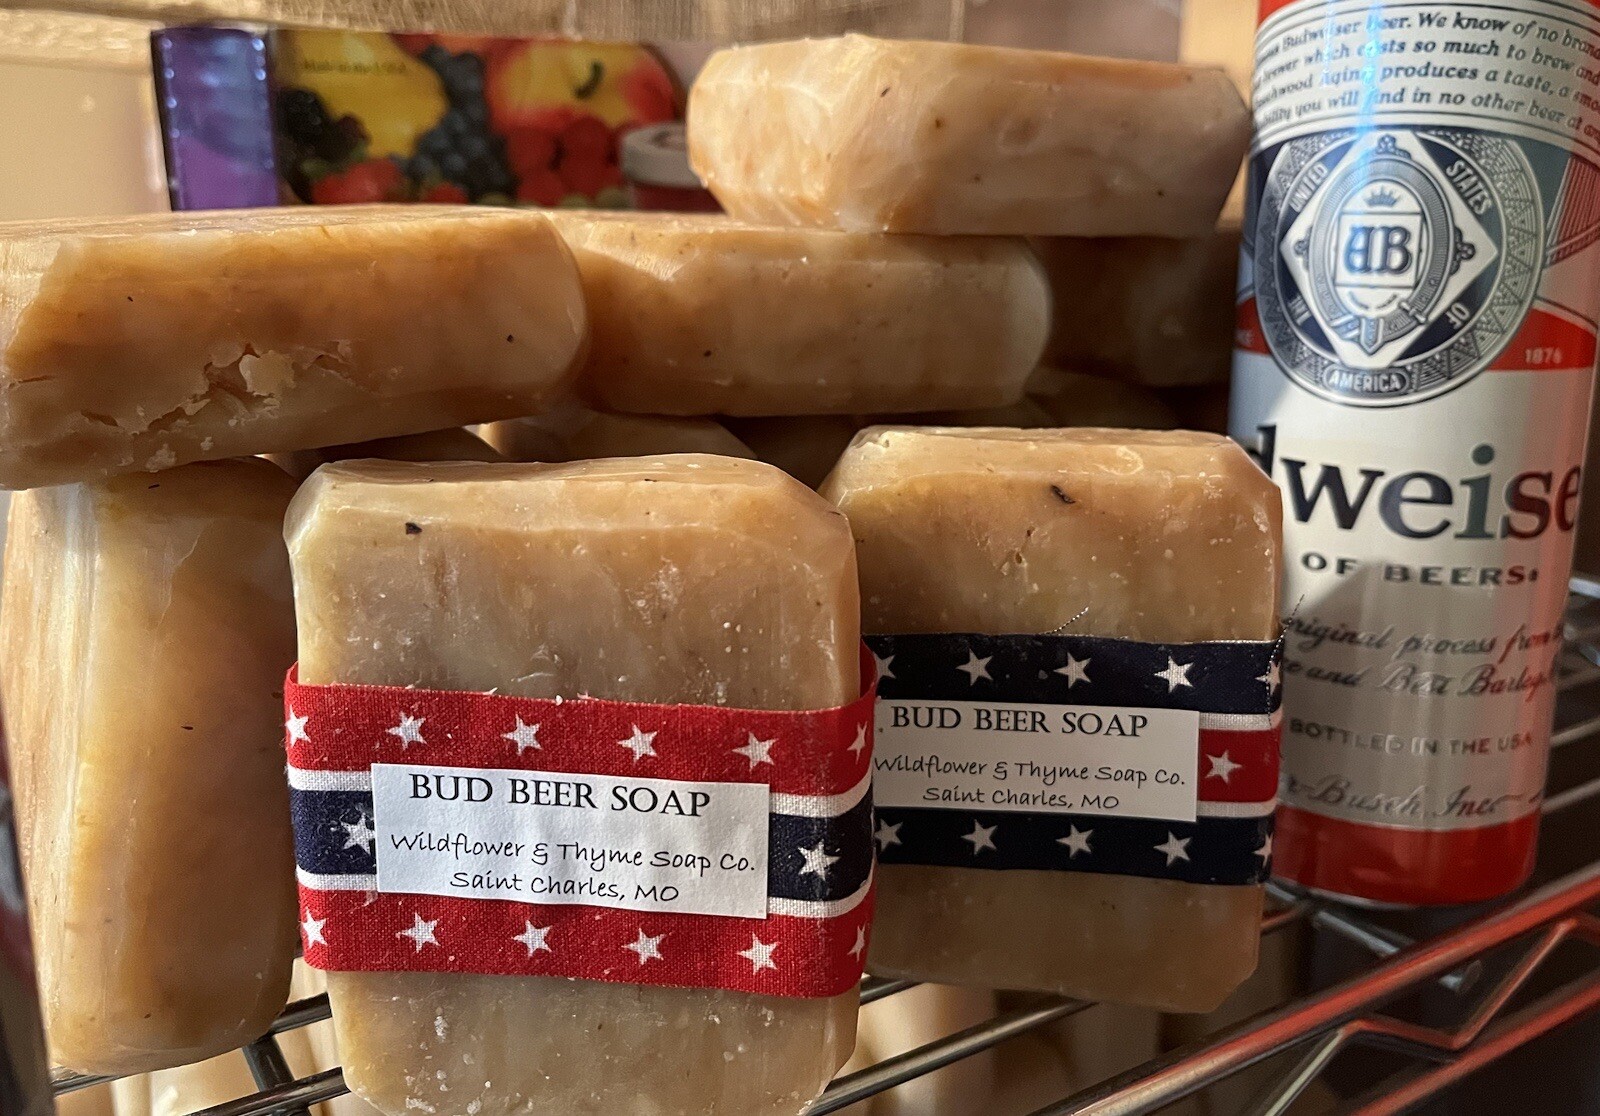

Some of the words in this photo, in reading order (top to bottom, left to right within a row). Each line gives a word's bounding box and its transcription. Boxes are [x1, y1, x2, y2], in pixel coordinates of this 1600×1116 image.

[1418, 12, 1447, 28] We
[1452, 12, 1511, 31] know
[1512, 20, 1537, 39] of
[1536, 26, 1558, 42] no
[1304, 43, 1350, 63] whch
[1357, 39, 1406, 57] csts
[1412, 39, 1436, 54] so
[1443, 39, 1500, 57] much
[1505, 44, 1527, 61] to
[1531, 48, 1576, 70] brew
[1380, 61, 1478, 82] produces
[1485, 69, 1499, 82] a
[1504, 69, 1554, 96] taste,
[1559, 86, 1570, 98] a
[1329, 90, 1359, 108] will
[1412, 87, 1432, 104] in
[1439, 91, 1465, 105] no
[1470, 92, 1525, 113] other
[1528, 99, 1566, 122] beer
[1289, 163, 1328, 213] UNITED
[1446, 160, 1492, 215] STATES
[1444, 302, 1470, 329] OF
[1328, 370, 1402, 393] AMERICA
[1302, 552, 1358, 575] OF
[891, 705, 961, 729] BUD
[973, 707, 1052, 734] BEER
[1061, 711, 1149, 738] SOAP
[1290, 718, 1404, 755] BOTTLED
[1450, 737, 1491, 756] THE
[874, 754, 986, 779] Wildflower
[993, 761, 1009, 781] &
[1015, 761, 1089, 786] Thyme
[1094, 766, 1148, 789] Soap
[1155, 769, 1186, 786] Co.
[408, 773, 493, 803] BUD
[507, 778, 599, 810] BEER
[611, 785, 711, 817] SOAP
[922, 785, 985, 804] Saint
[991, 789, 1073, 808] Charles,
[1081, 795, 1120, 810] MO
[390, 831, 525, 861] Wildflower
[532, 843, 549, 866] &
[557, 842, 644, 872] Thyme
[649, 851, 713, 878] Soap
[719, 852, 755, 872] Co.
[450, 870, 523, 891] Saint
[530, 875, 626, 901] Charles,
[634, 884, 679, 902] MO
